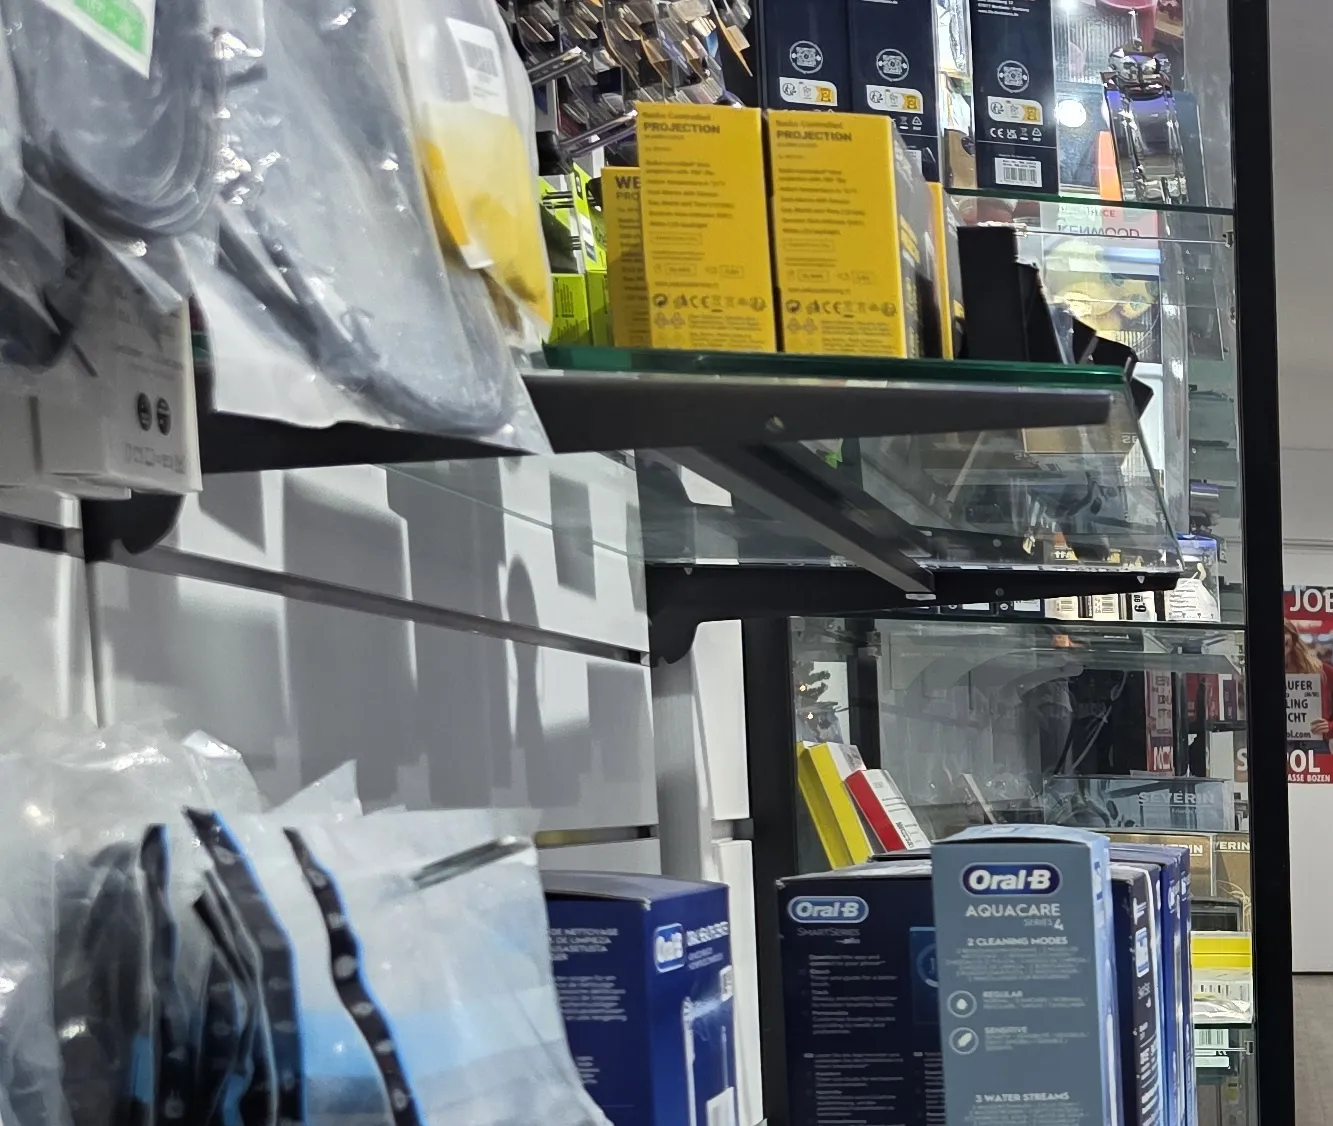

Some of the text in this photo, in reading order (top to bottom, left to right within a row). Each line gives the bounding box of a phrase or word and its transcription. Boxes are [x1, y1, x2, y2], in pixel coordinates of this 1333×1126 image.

[644, 122, 720, 134] PROJECTION
[776, 129, 852, 142] PROJECTION
[1285, 680, 1313, 691] UFER
[1306, 773, 1331, 783] BOZEN
[969, 869, 1052, 890] Oral-B
[795, 901, 860, 917] Oral-B
[965, 903, 1061, 918] AQUACARE
[1023, 918, 1064, 931] SERIES 4
[967, 936, 1068, 946] 2 CLEANING MODES
[975, 1092, 1070, 1103] 3 WATER STREAMS
